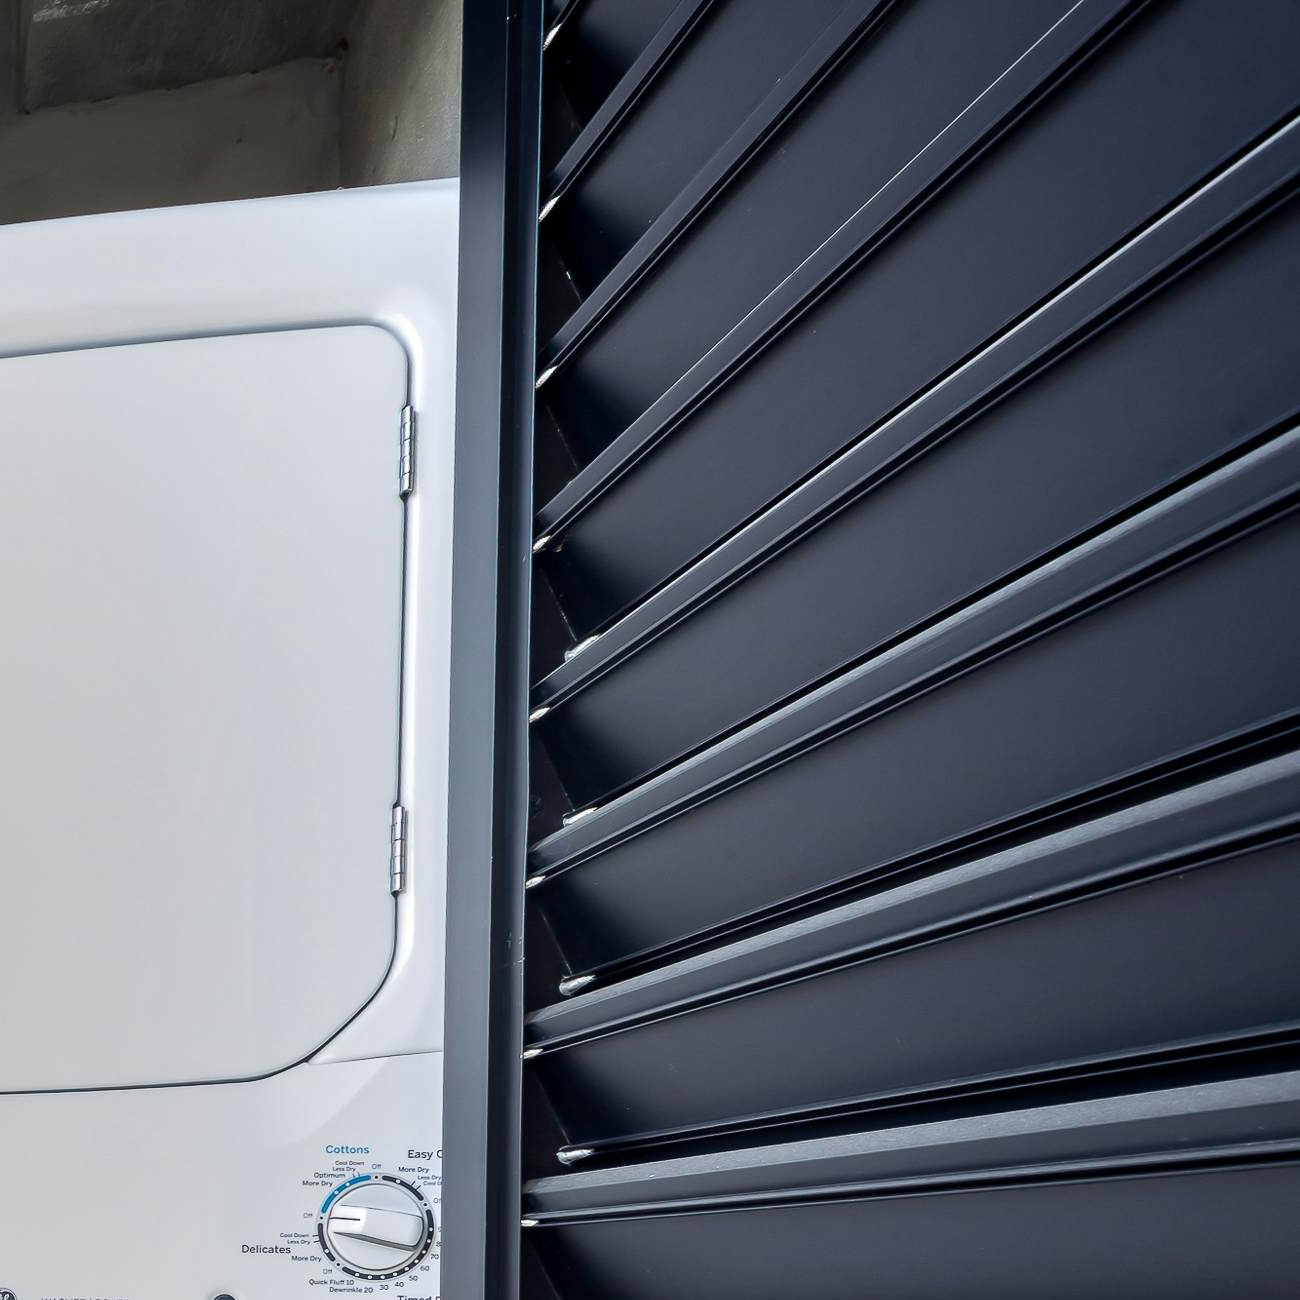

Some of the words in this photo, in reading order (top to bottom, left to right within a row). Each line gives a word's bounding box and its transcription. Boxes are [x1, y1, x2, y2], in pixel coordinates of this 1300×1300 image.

[326, 1145, 370, 1154] Cottons
[408, 1150, 433, 1160] Easy
[241, 1244, 291, 1253] Delicates
